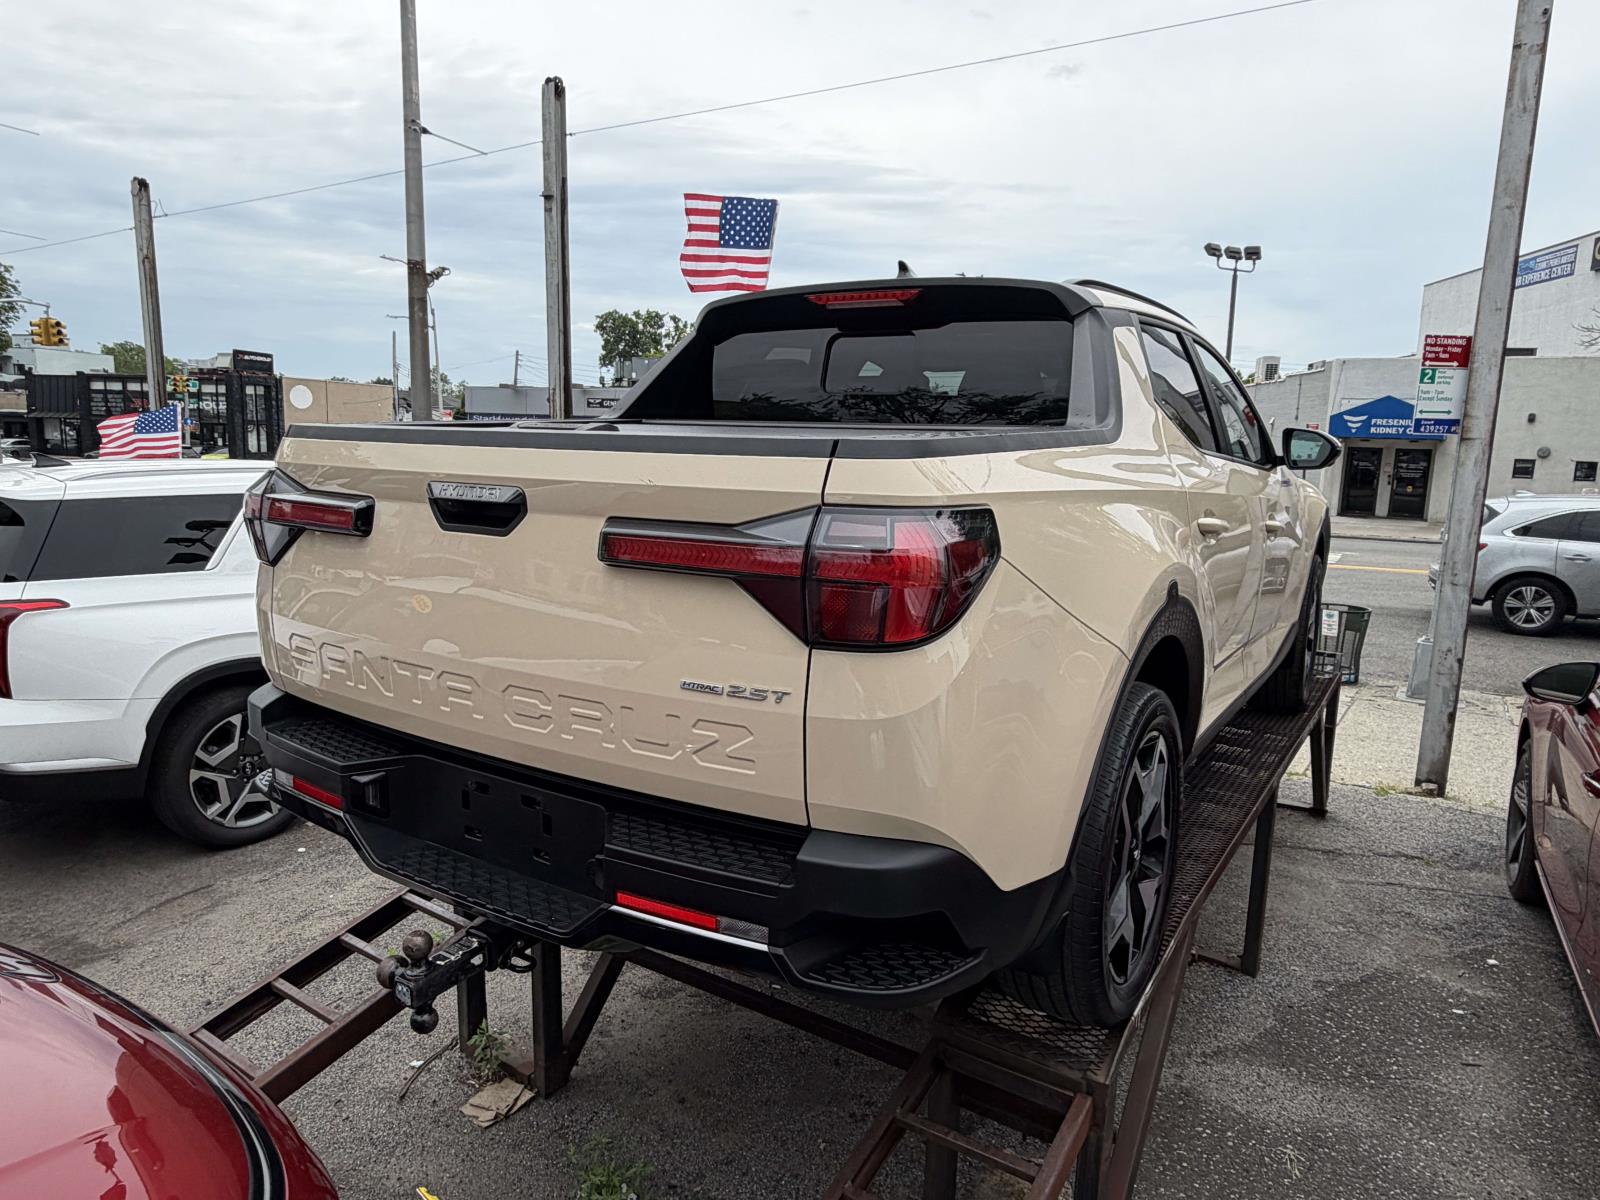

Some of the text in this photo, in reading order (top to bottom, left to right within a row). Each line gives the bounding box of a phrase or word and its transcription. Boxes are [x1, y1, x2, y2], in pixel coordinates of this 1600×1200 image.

[1552, 264, 1571, 278] CENTER
[1424, 369, 1432, 382] 2
[438, 484, 502, 500] HYUNDAI
[682, 680, 720, 693] HTRAC
[289, 632, 756, 774] SANTA CRUZ
